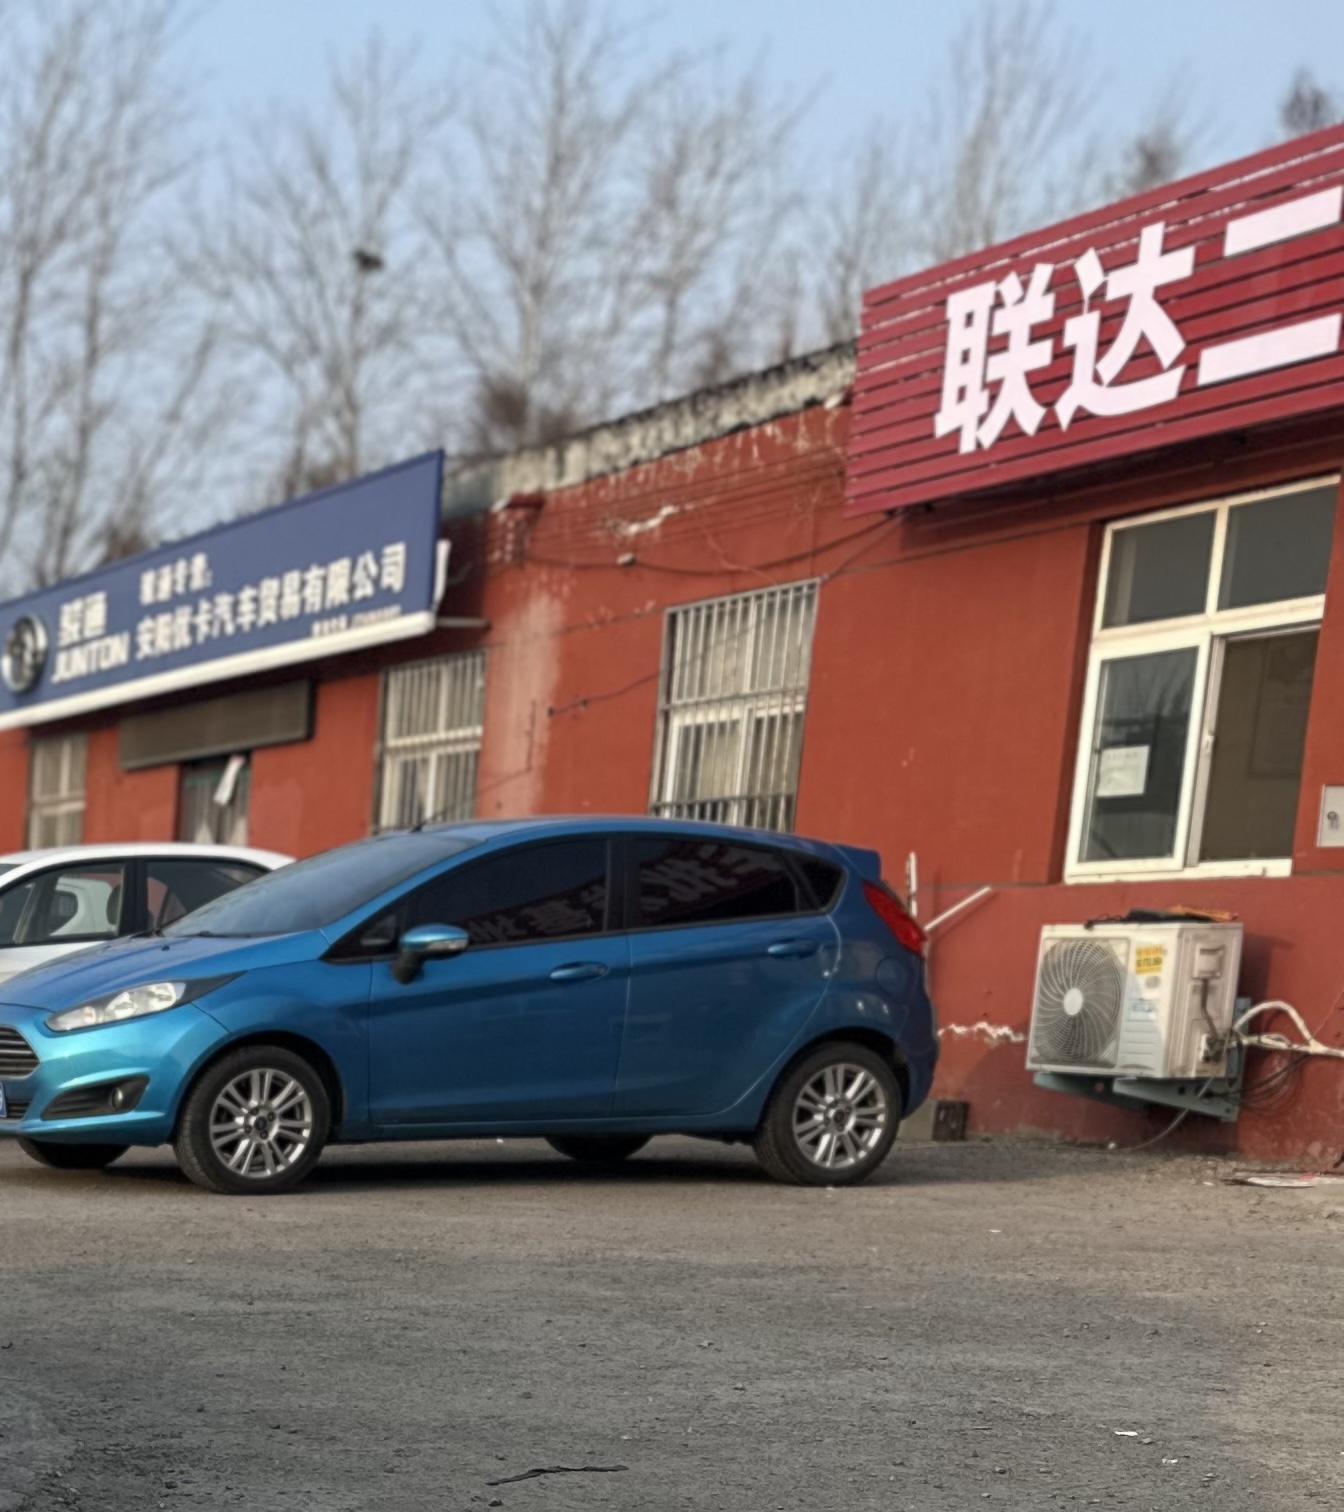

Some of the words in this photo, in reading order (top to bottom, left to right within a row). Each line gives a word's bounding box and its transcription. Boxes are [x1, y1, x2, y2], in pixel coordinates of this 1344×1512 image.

[934, 186, 1342, 454] 联达二
[51, 632, 131, 684] JUNTON
